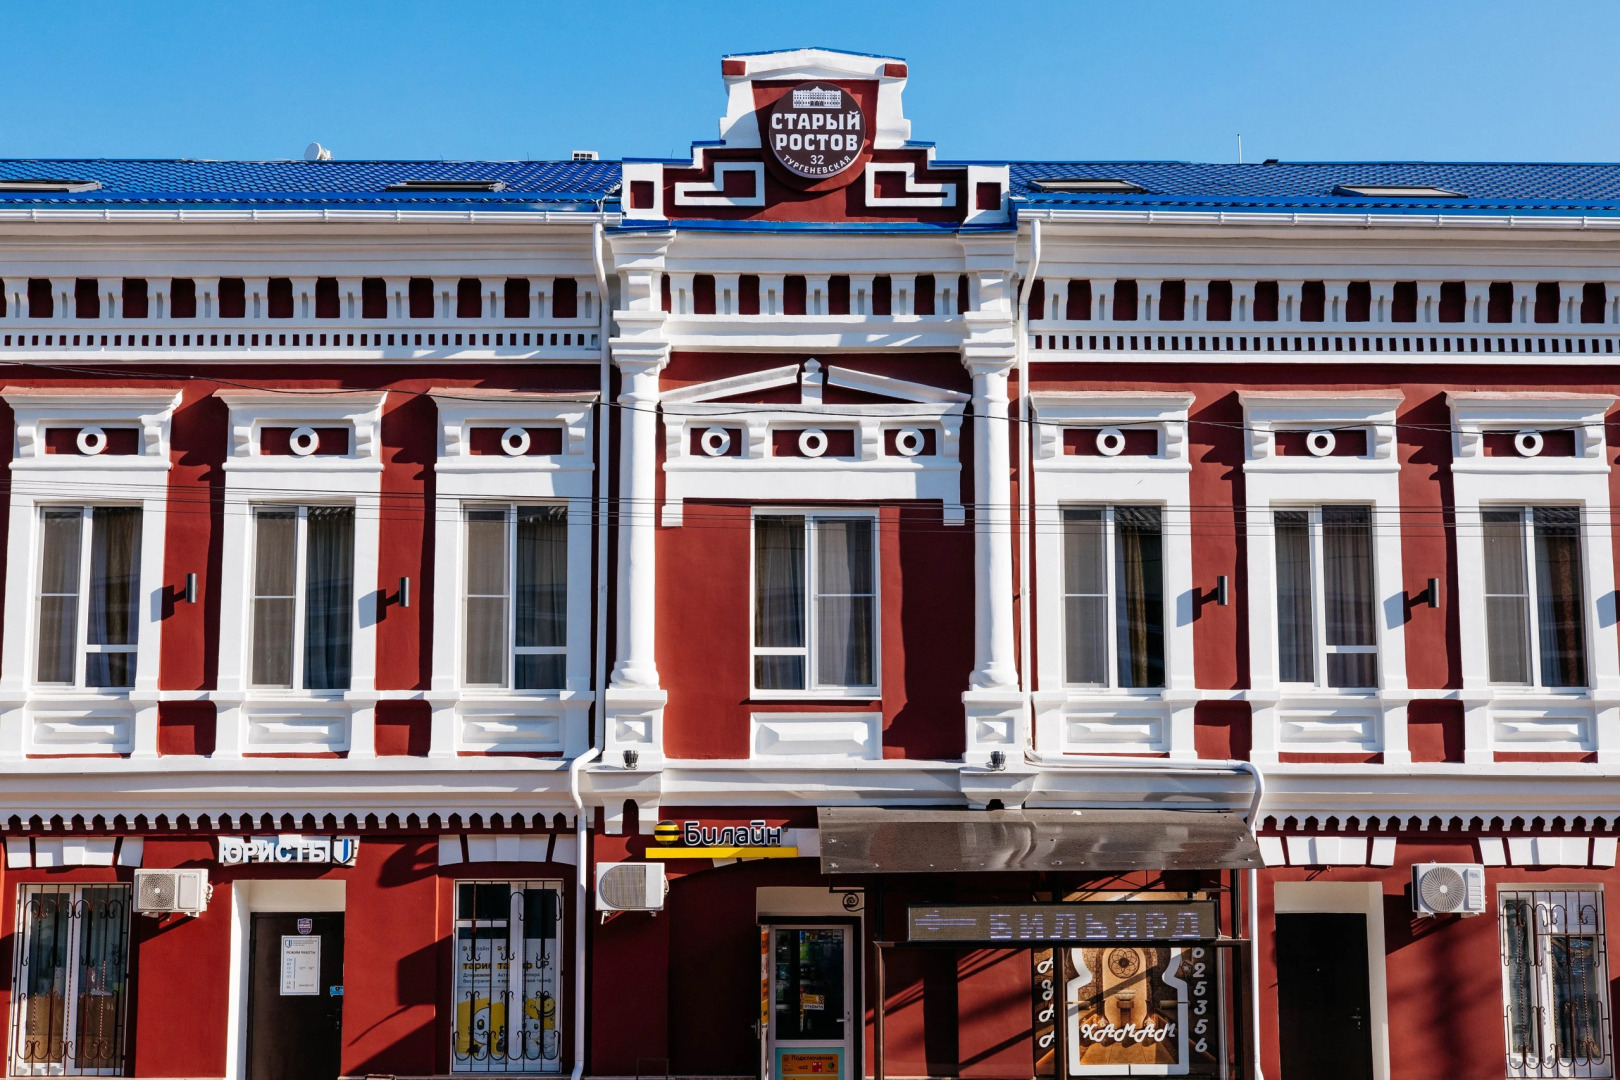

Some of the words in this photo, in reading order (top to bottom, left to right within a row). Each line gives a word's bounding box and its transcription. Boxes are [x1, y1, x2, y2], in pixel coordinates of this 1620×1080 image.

[771, 110, 860, 130] СТАРЫЙ
[775, 133, 858, 151] РОСТОВ
[783, 154, 851, 174] ТУРГЕНЕВСКАЯ
[810, 154, 824, 165] 32
[684, 820, 782, 847] Билайн
[218, 842, 331, 864] ЮРИСТЫ
[989, 913, 1201, 939] БИЛЬЯРД
[1080, 1022, 1176, 1043] ХАМАМ
